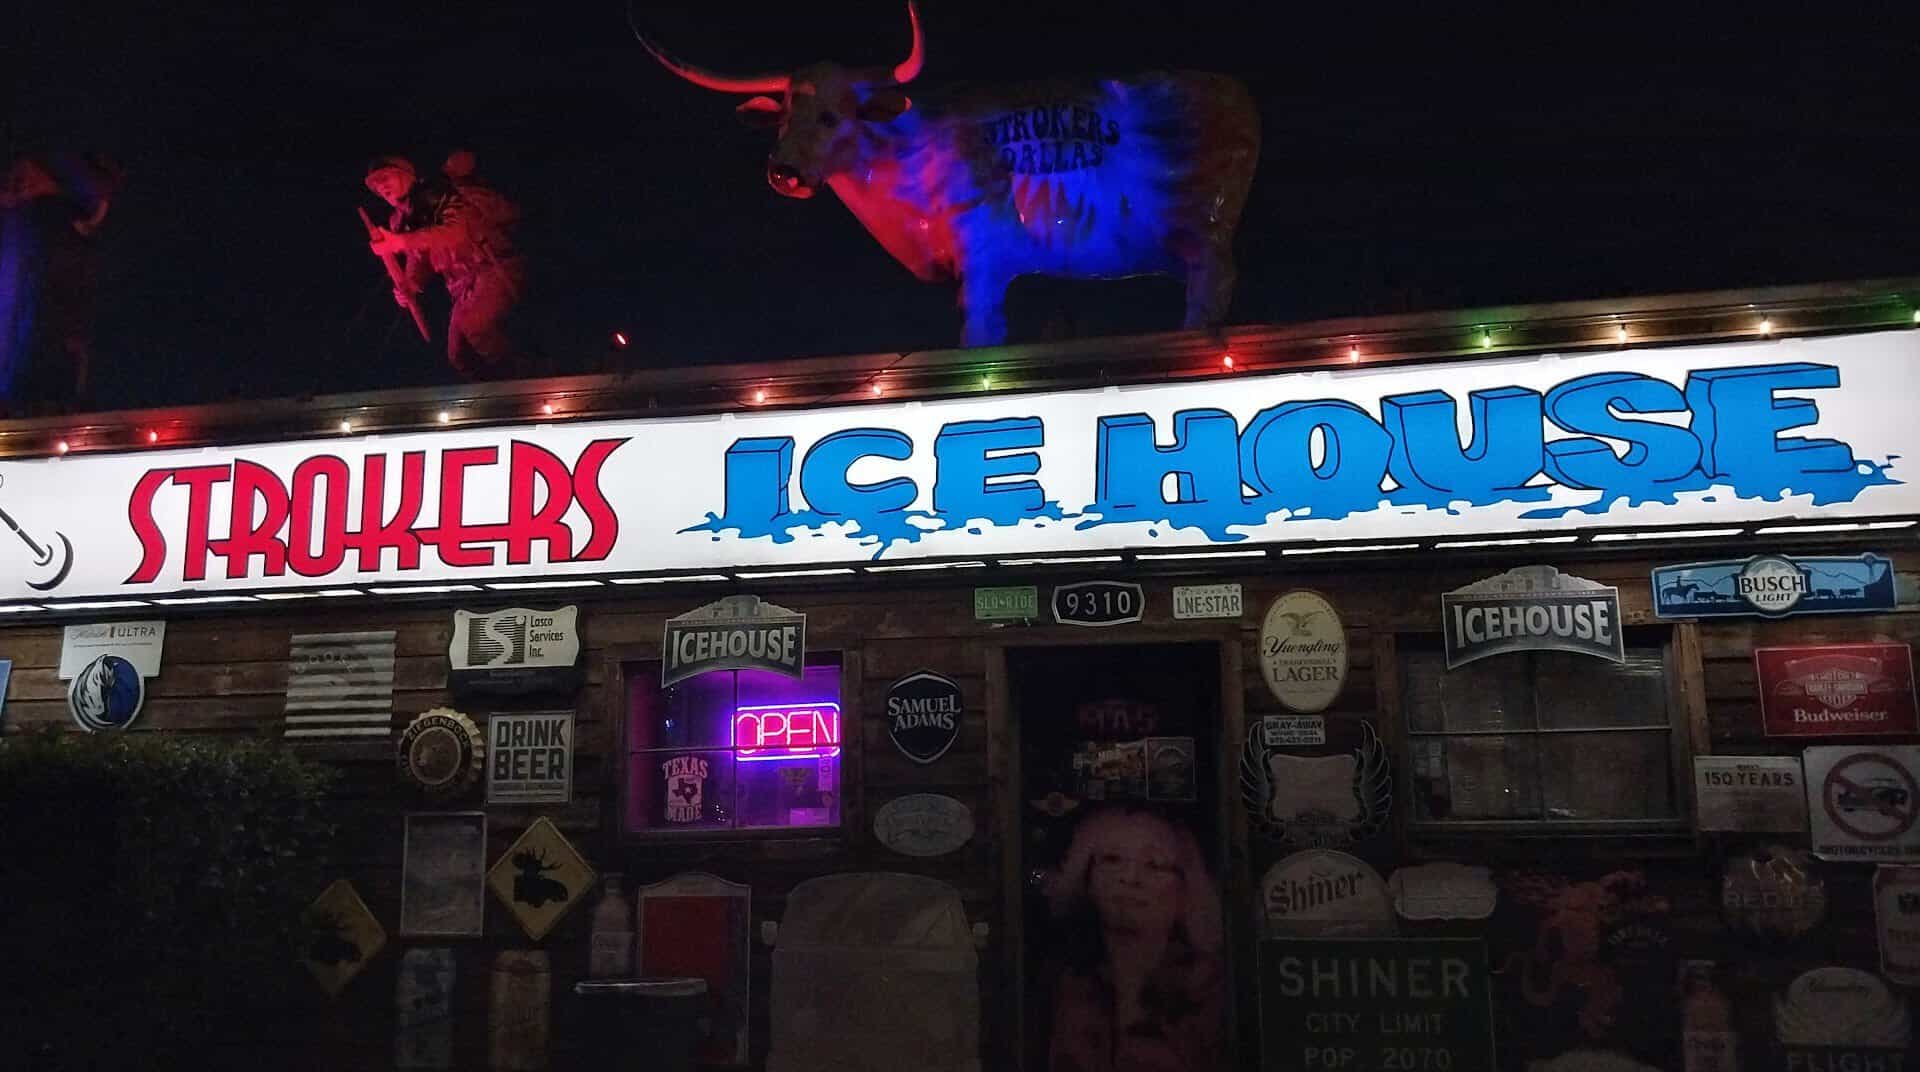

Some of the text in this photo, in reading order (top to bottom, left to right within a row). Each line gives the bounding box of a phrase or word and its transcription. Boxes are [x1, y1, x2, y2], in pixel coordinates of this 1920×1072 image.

[982, 104, 1120, 145] STROKERS
[1002, 142, 1103, 175] DALLAS
[122, 363, 1858, 585] STROKERS ICE HOUSE
[1741, 575, 1805, 594] BUSCH
[1066, 590, 1131, 616] 9310
[1755, 591, 1793, 602] LIGHT
[118, 626, 156, 637] ULTRA
[530, 616, 553, 627] Lasco
[1453, 600, 1613, 649] ICEHOUSE
[530, 630, 564, 641] Services
[1263, 635, 1339, 658] Yuengling
[529, 645, 545, 657] Inc.
[671, 626, 796, 670] ICEHOUSE
[1273, 665, 1338, 682] LAGER
[888, 694, 961, 717] SAMUEL
[1793, 708, 1888, 723] Budweiser
[496, 718, 567, 748] DRINK
[737, 710, 838, 755] OPEN
[894, 712, 955, 733] ADAMS
[493, 748, 566, 781] BEER
[662, 756, 708, 780] TEXAS
[1705, 771, 1793, 786] 150 YEARS
[667, 805, 702, 823] MADE
[1268, 871, 1362, 915] Shiner
[1279, 956, 1473, 999] SHINER
[1304, 1009, 1444, 1034] CITY LIMIT
[1304, 1048, 1450, 1071] POP 2070
